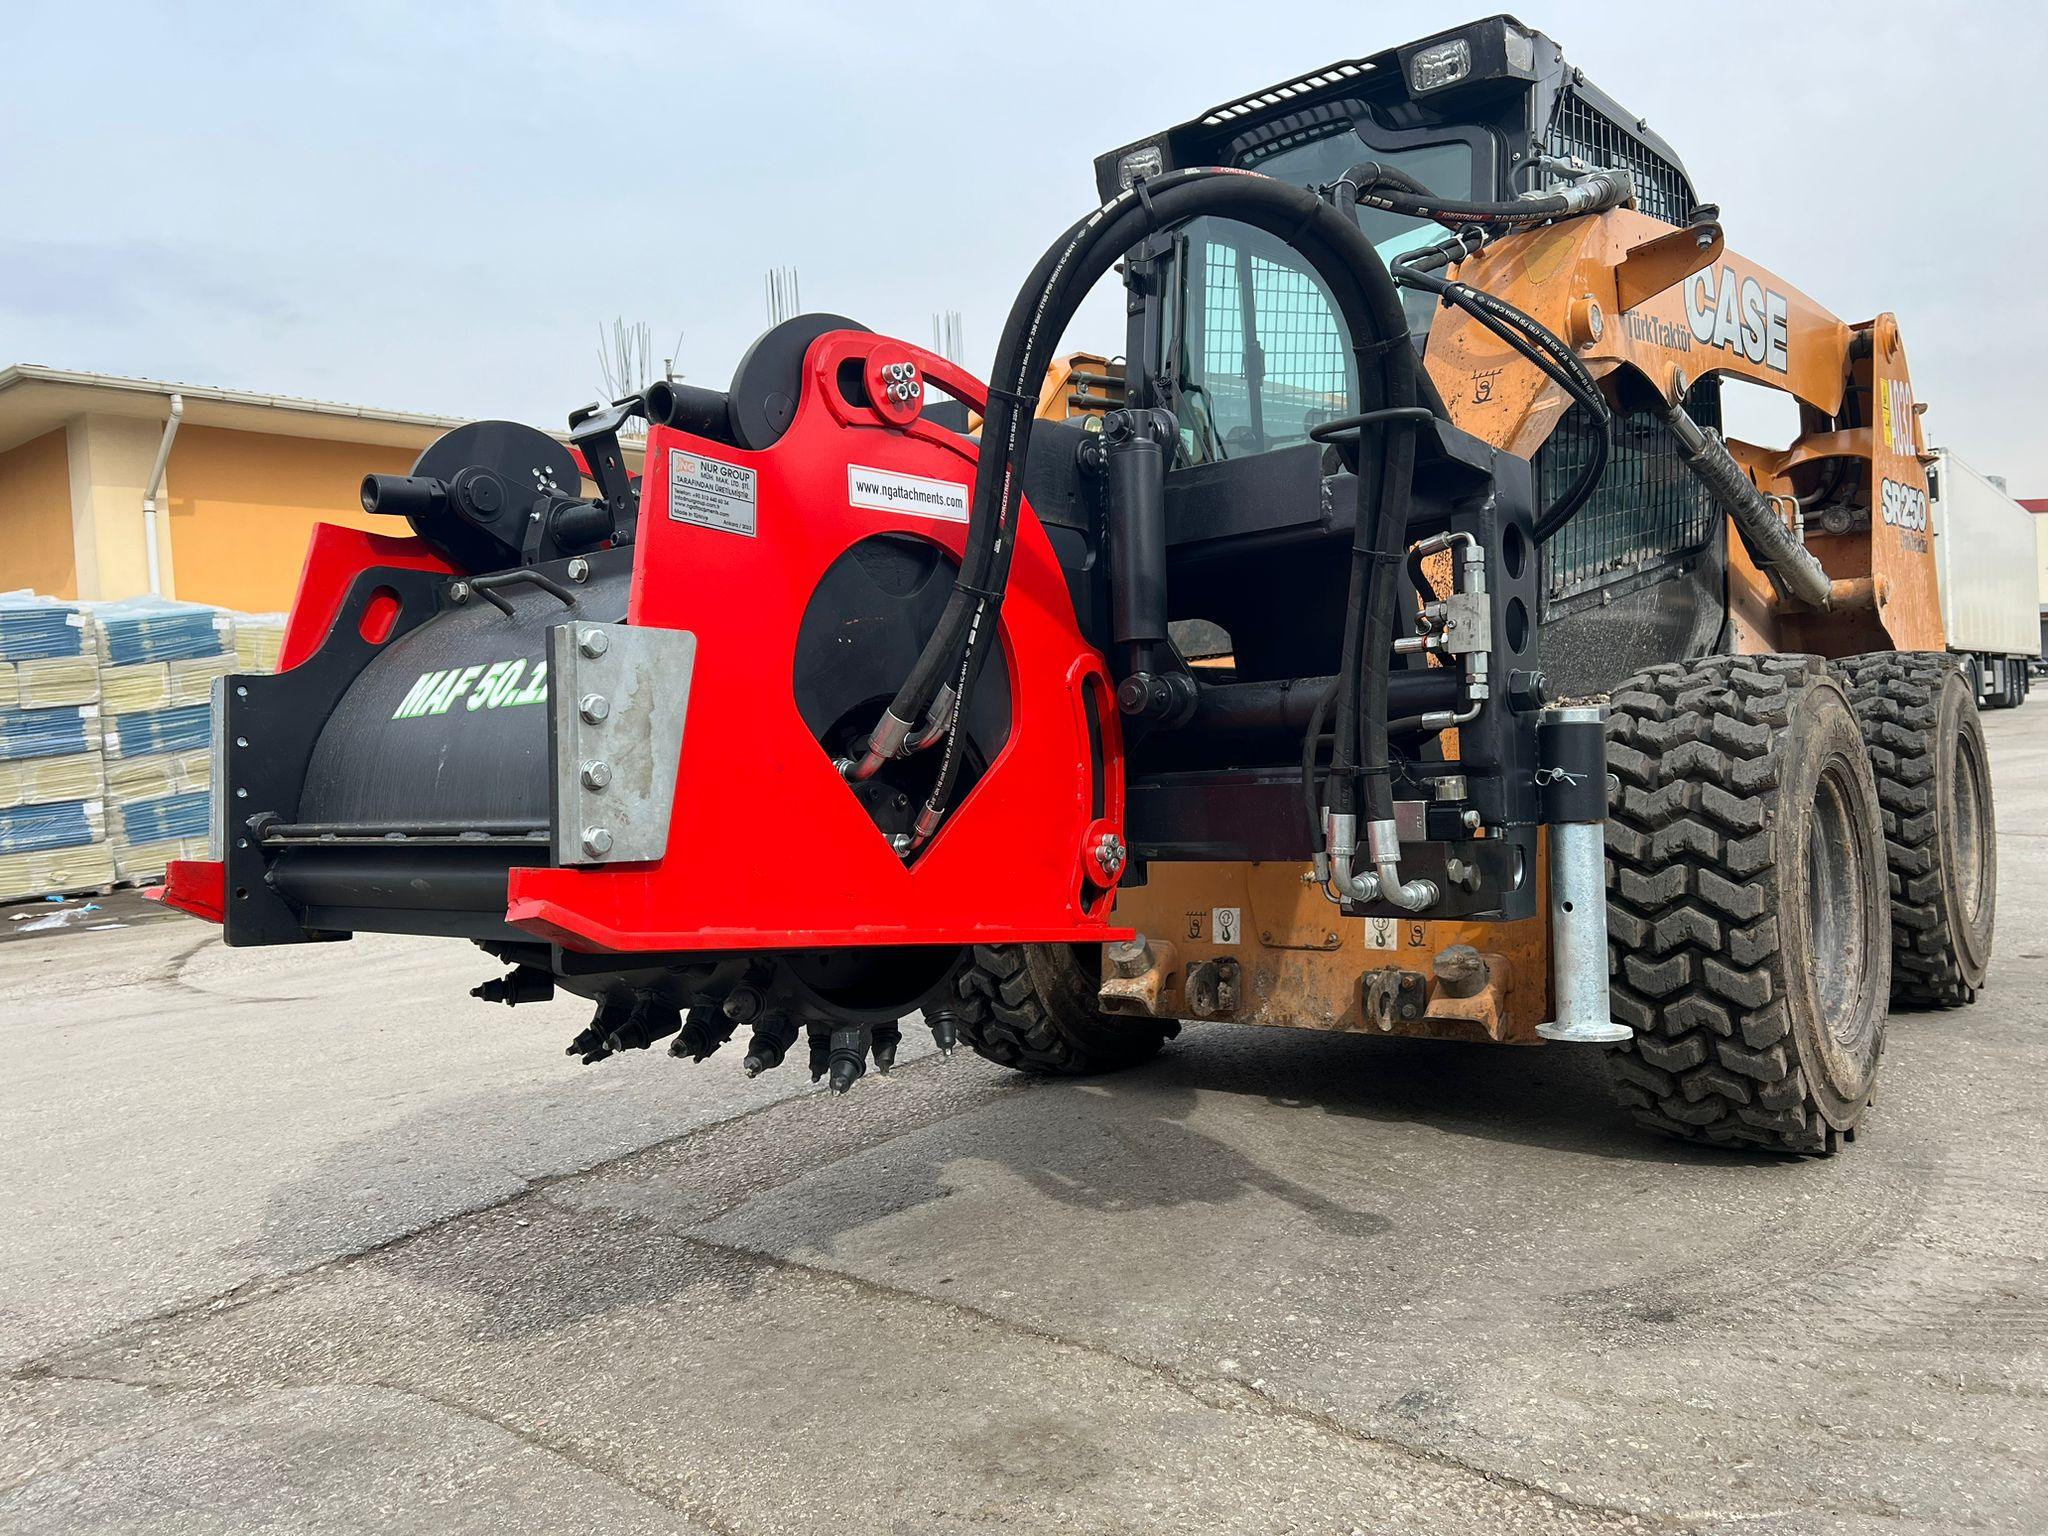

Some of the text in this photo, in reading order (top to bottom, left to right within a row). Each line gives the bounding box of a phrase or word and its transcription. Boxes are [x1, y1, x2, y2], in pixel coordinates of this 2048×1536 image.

[1627, 310, 1691, 352] TürkTraktör
[1683, 265, 1787, 374] CASE
[677, 475, 714, 490] TARAFINDAN
[701, 461, 750, 481] NUR GROUP
[856, 481, 963, 508] www.ngattachments.com
[1881, 477, 1926, 532] SR250
[391, 663, 487, 720] MAF
